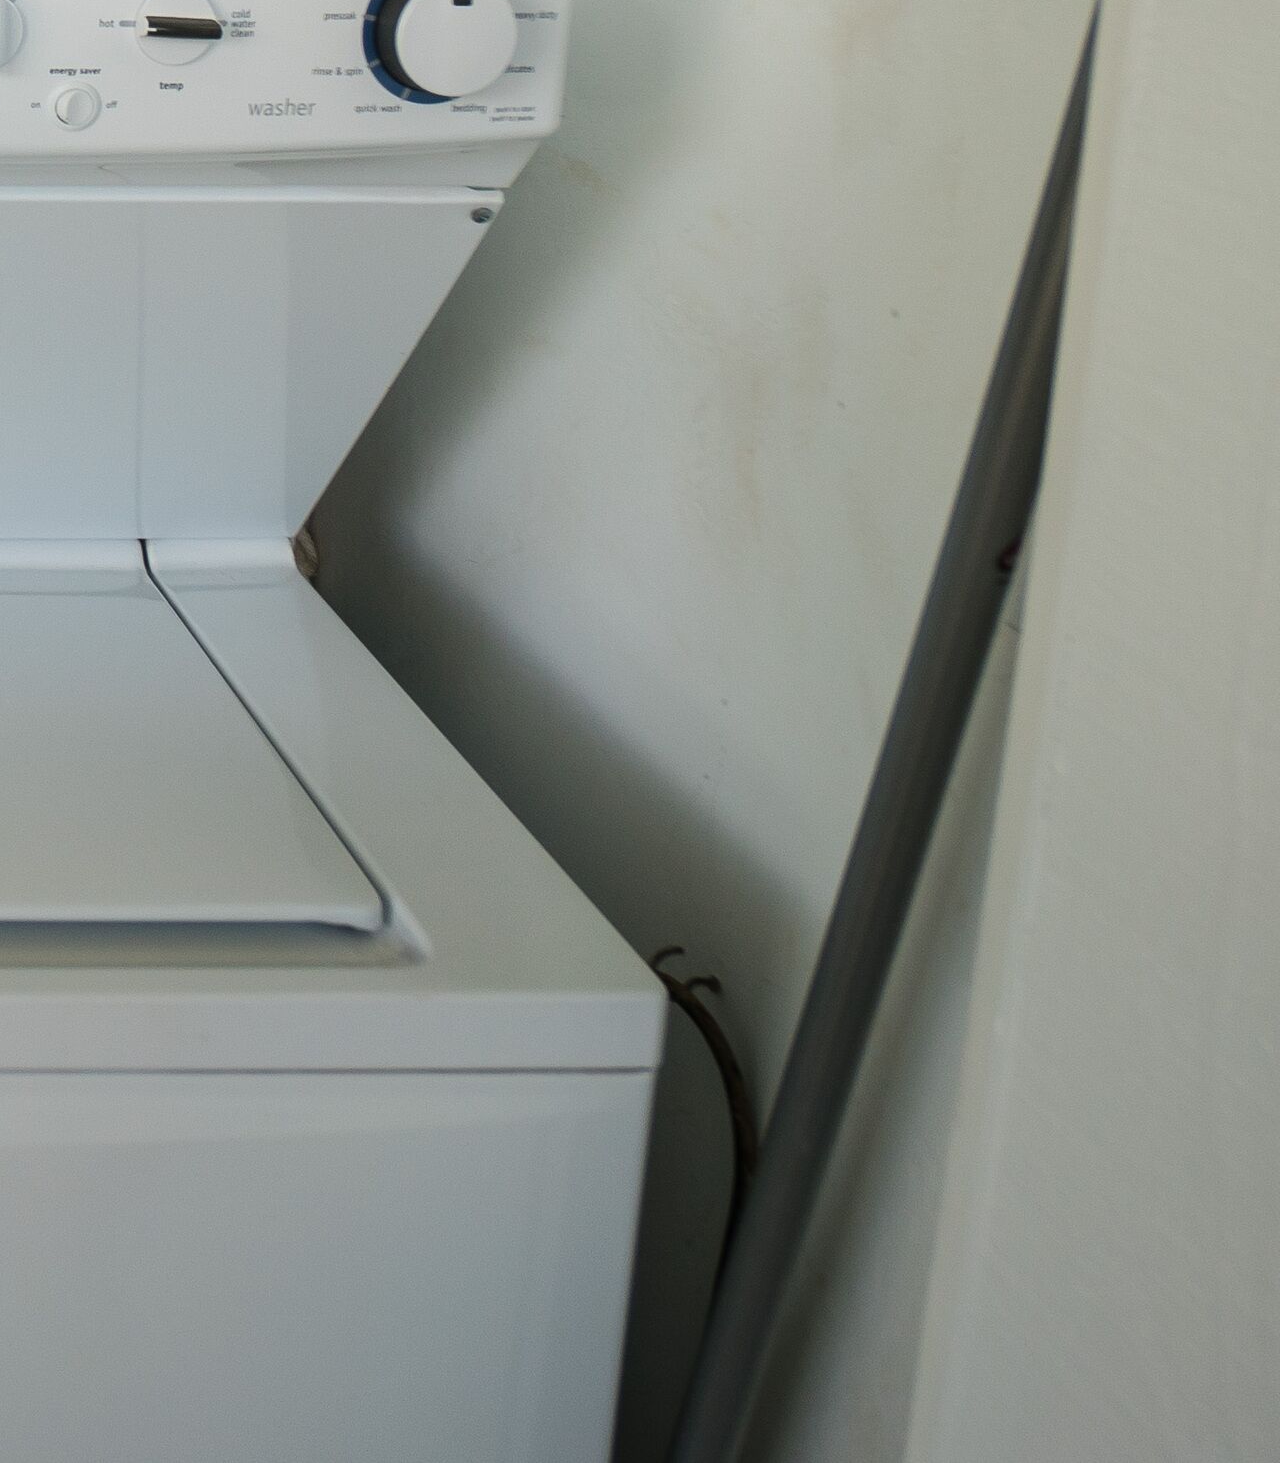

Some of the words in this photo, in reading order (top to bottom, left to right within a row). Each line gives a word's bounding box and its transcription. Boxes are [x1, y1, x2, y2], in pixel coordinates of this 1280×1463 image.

[98, 19, 114, 28] hot
[49, 67, 77, 77] energy
[79, 67, 101, 75] saver
[159, 81, 184, 91] temp
[30, 101, 41, 109] on
[105, 100, 118, 109] off
[248, 98, 316, 117] washer
